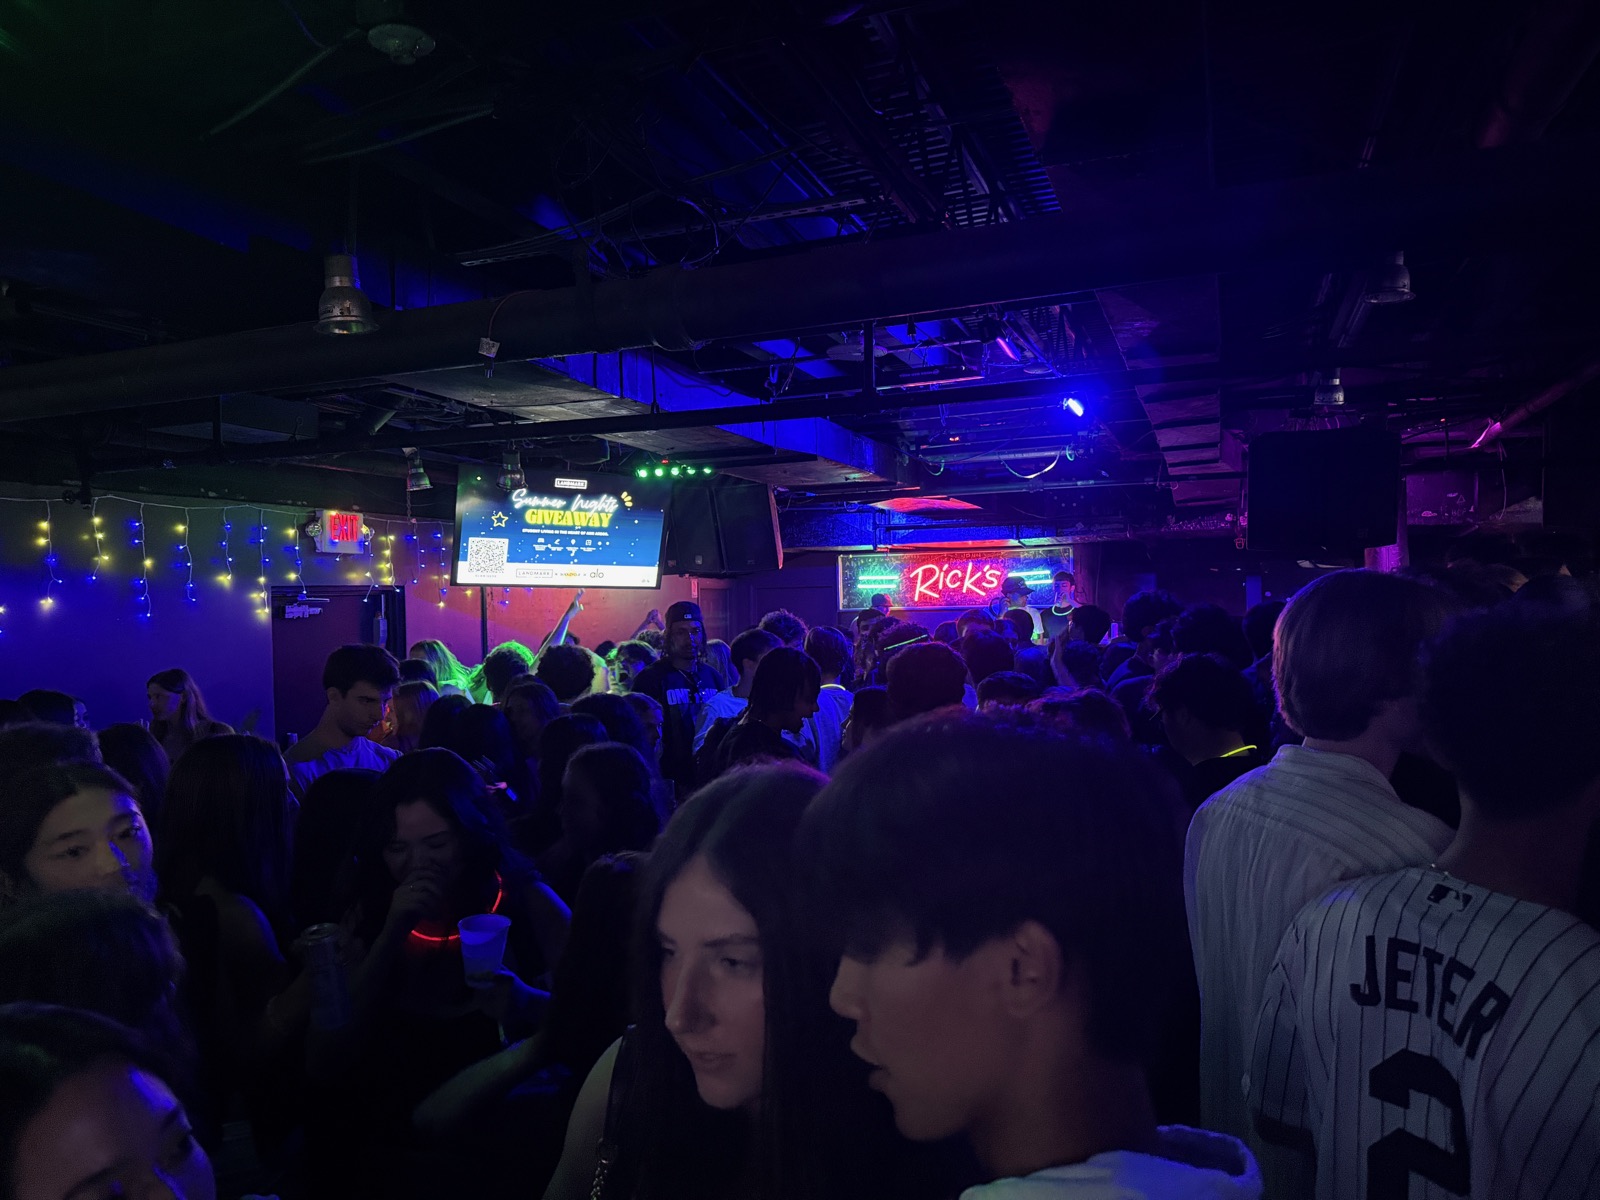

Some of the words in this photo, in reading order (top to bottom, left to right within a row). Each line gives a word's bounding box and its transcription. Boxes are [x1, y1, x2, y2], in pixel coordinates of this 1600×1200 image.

[512, 488, 567, 509] Summer
[330, 512, 360, 542] EXIT
[525, 509, 613, 528] GIVEAWAY
[1350, 934, 1512, 1061] JETER
[1367, 1048, 1471, 1200] 2
